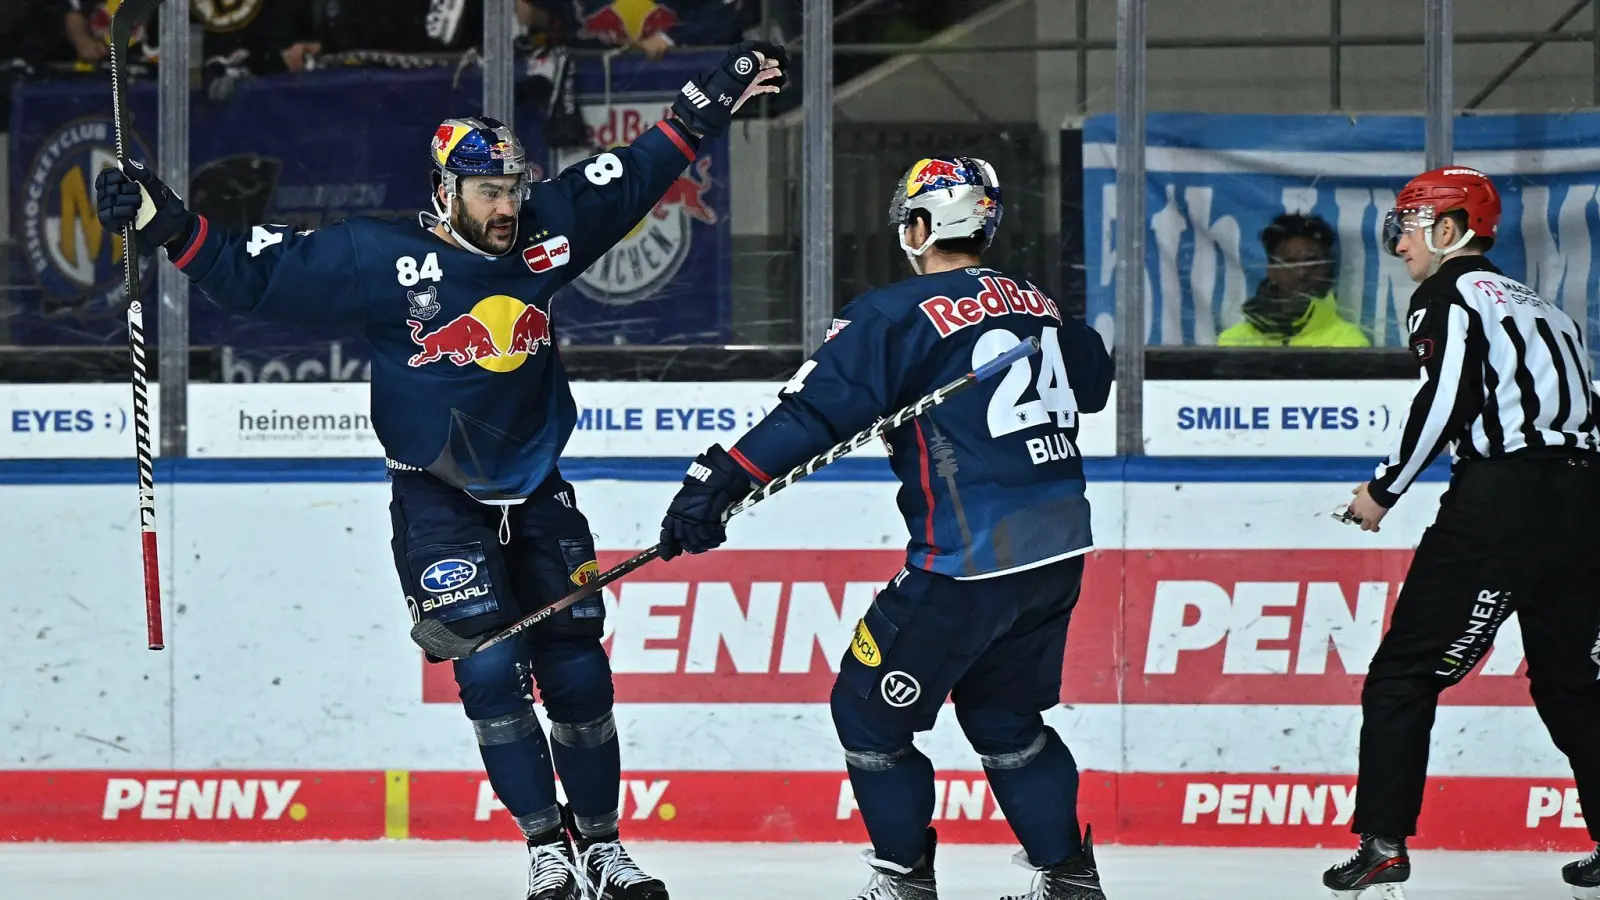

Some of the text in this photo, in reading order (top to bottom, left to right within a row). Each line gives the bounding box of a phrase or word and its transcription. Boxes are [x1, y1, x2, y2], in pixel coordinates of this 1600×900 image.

[718, 92, 733, 106] 84
[396, 252, 443, 287] 84
[919, 277, 1010, 338] Red
[971, 327, 1079, 439] 24
[12, 410, 94, 433] EYES
[655, 408, 736, 431] EYES
[1177, 406, 1269, 431] SMILE
[1281, 406, 1359, 431] EYES
[422, 583, 489, 612] SUBARU
[509, 624, 524, 637] LX
[522, 608, 552, 629] ALPHA
[603, 581, 889, 674] ENN
[1453, 644, 1482, 680] HOTELS
[1484, 590, 1513, 635] RESORTS
